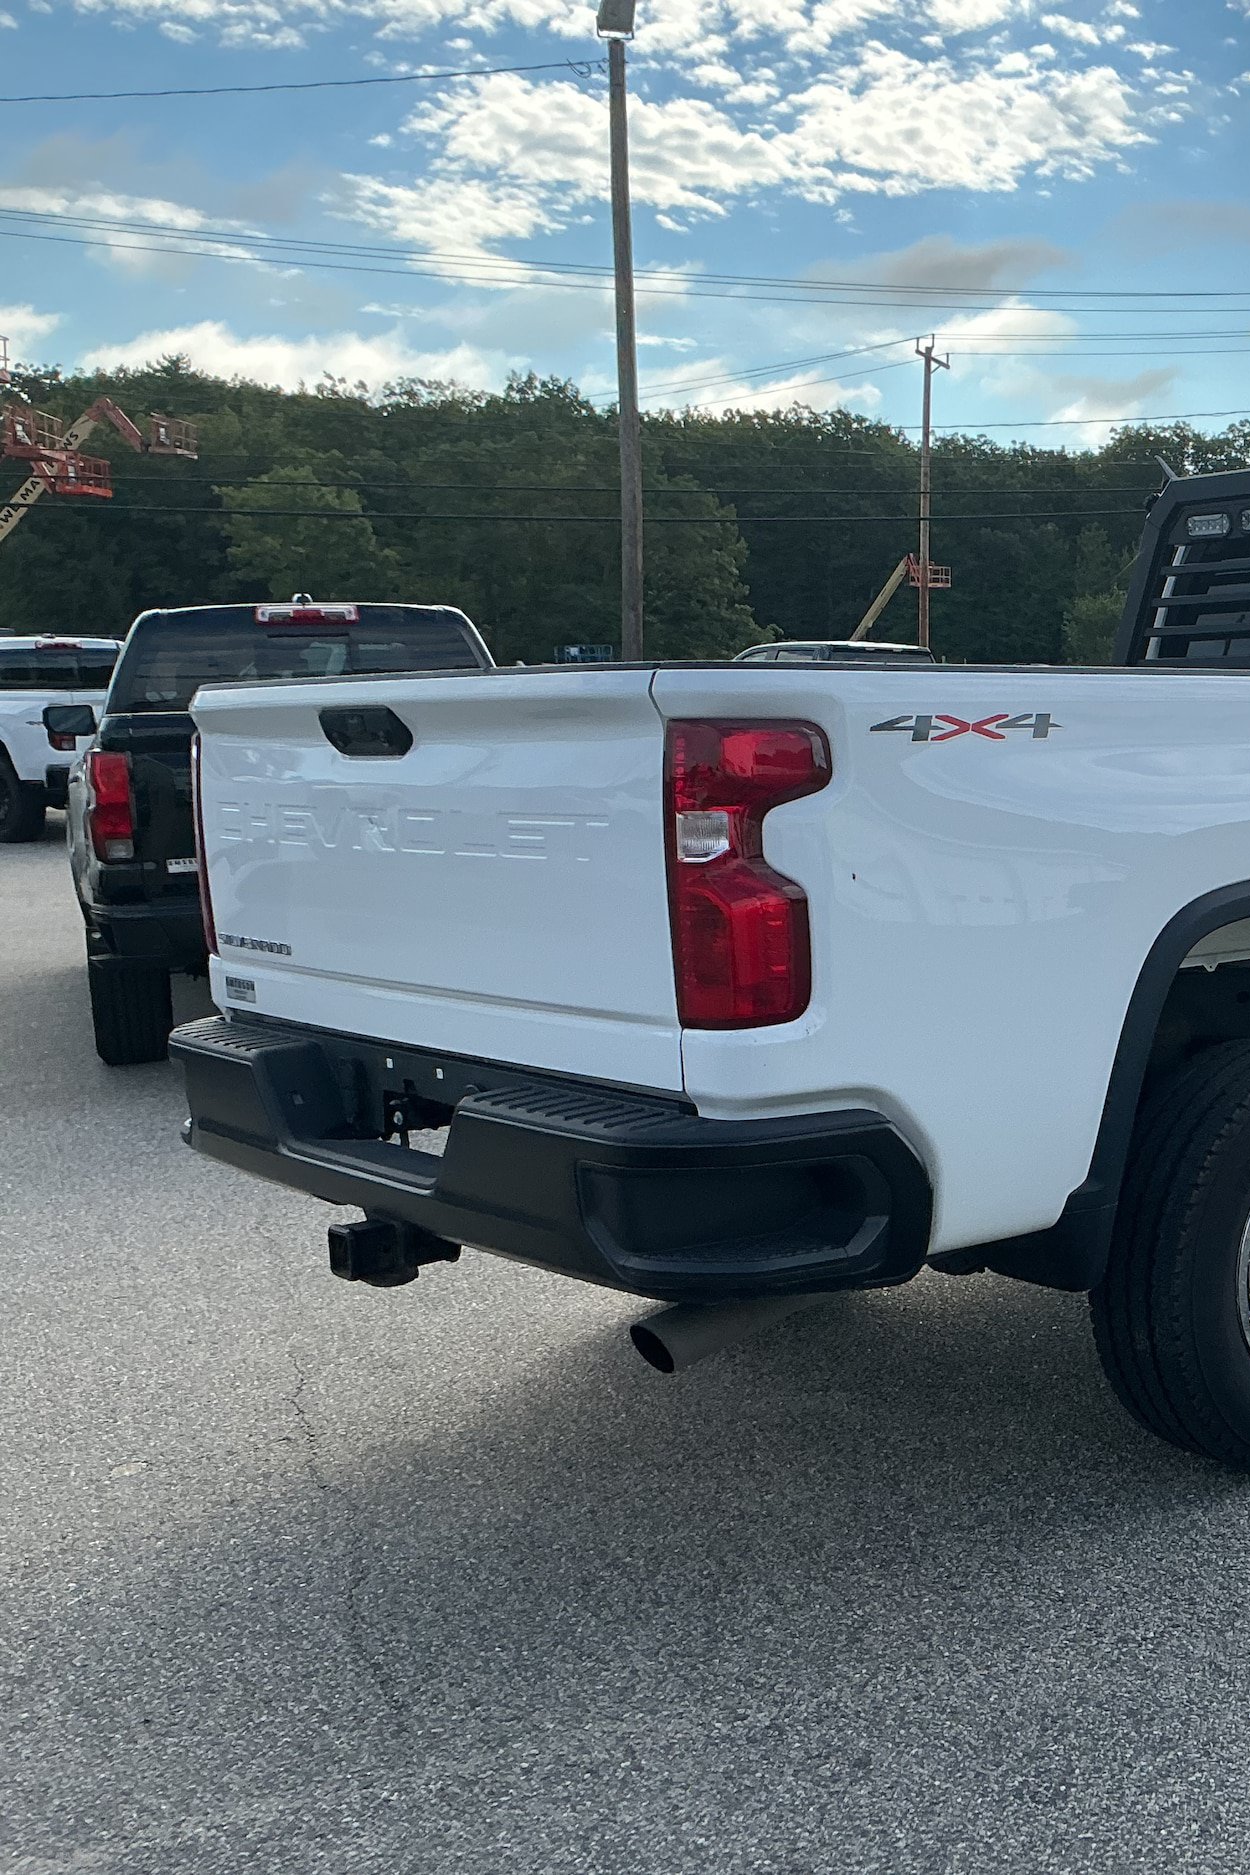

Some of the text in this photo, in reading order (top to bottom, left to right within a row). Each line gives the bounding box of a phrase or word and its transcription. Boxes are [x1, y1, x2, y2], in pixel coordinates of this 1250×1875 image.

[869, 713, 1064, 742] 4X4
[217, 801, 609, 861] CHEVROLET
[217, 932, 292, 956] SILVERADO
